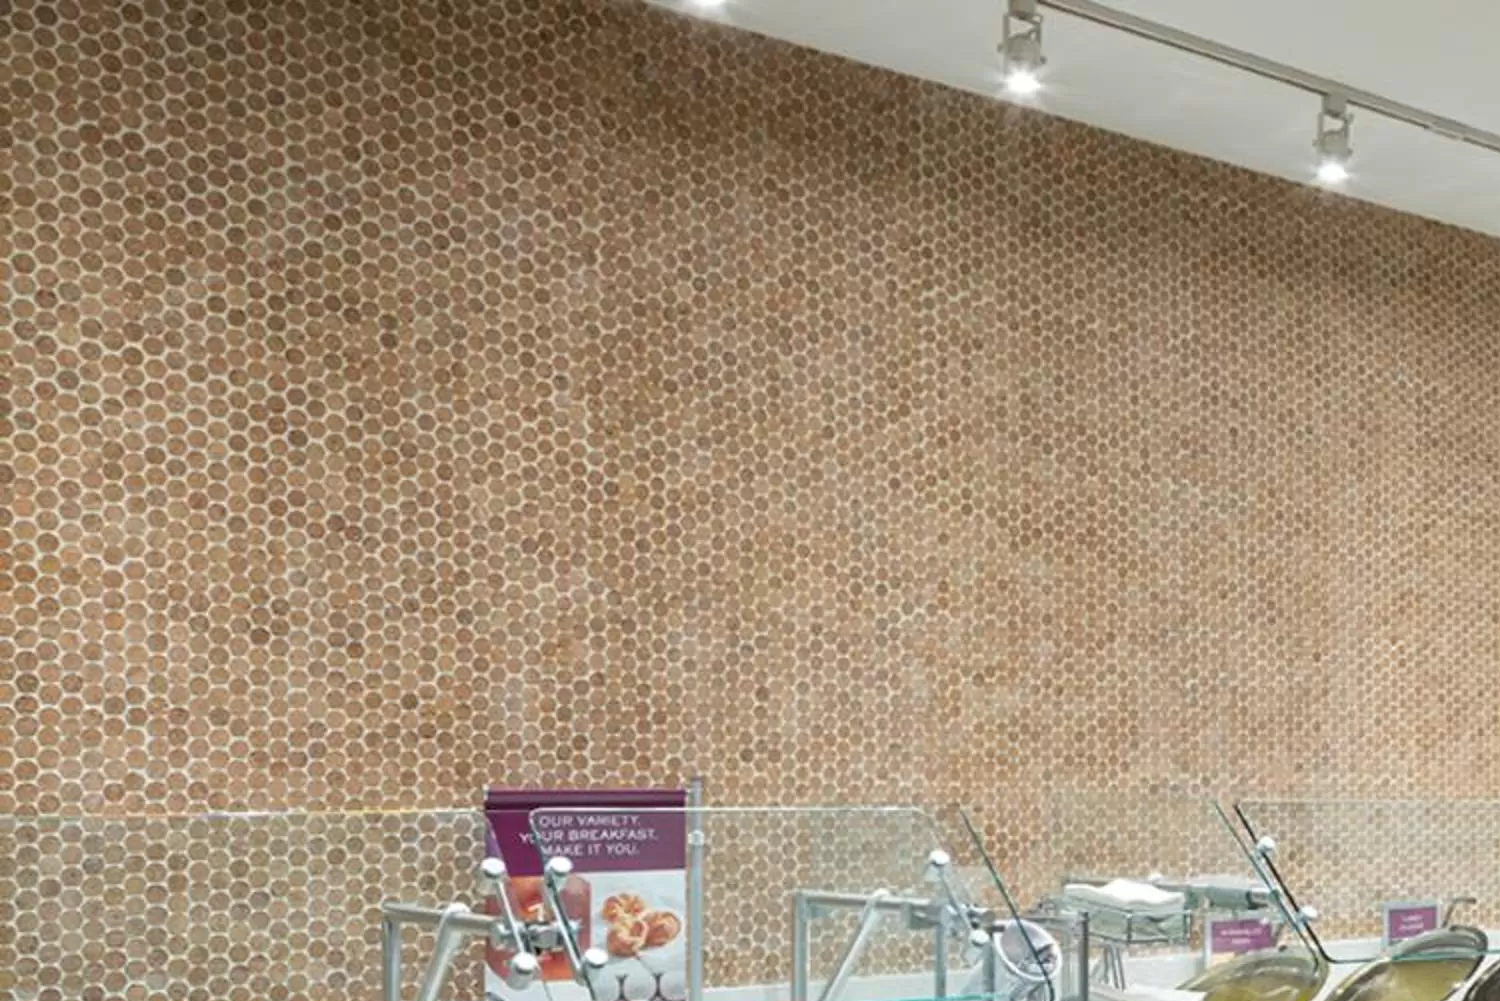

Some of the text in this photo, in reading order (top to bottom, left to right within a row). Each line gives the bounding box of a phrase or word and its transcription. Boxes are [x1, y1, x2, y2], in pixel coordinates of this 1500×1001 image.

[538, 815, 573, 828] OUR
[541, 842, 584, 856] MAKE
[587, 842, 603, 855] IT
